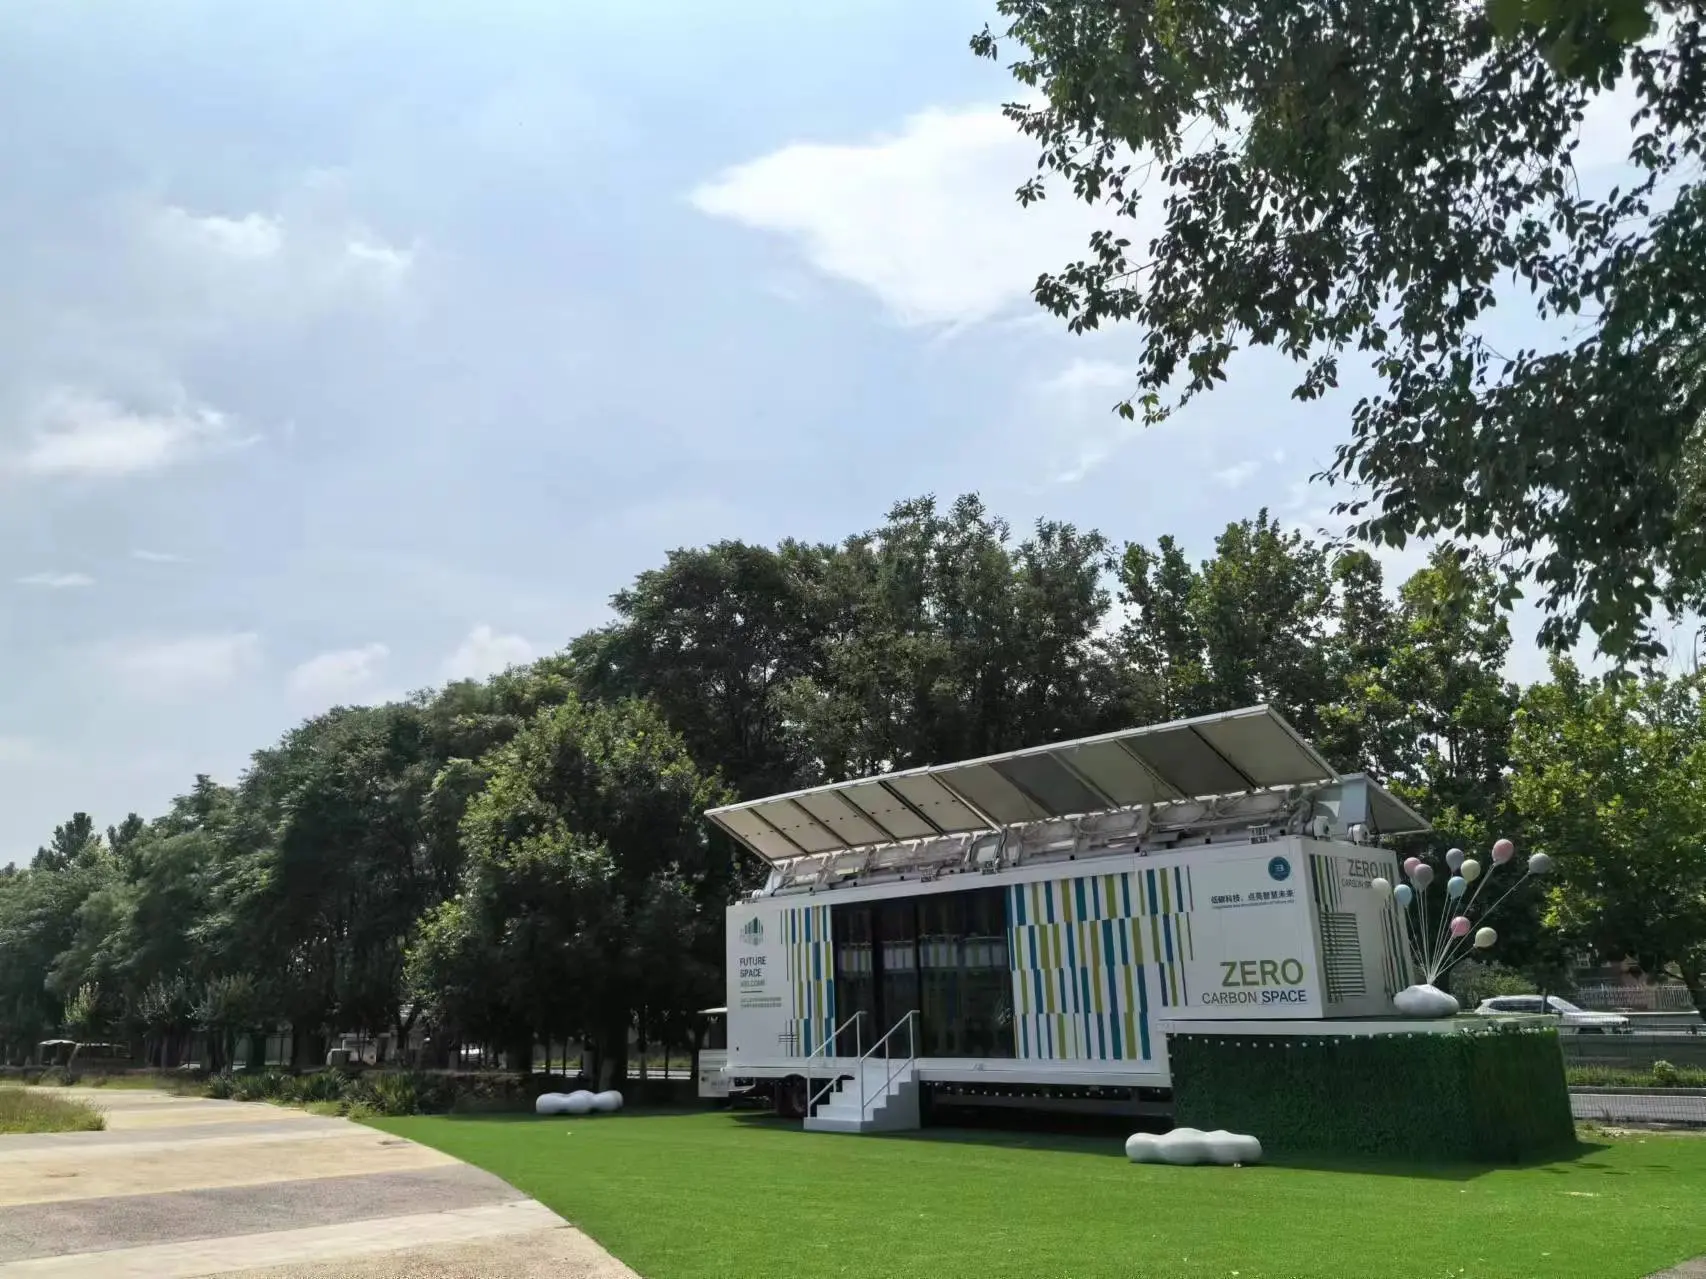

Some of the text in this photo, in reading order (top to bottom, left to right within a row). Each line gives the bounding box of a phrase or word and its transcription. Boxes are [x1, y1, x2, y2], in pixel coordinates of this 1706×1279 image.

[1347, 859, 1378, 879] ZERO
[739, 956, 766, 967] FUTURE
[740, 968, 762, 978] SPACE
[1220, 958, 1303, 987] ZERO
[1202, 990, 1306, 1004] CARBON SPACE
